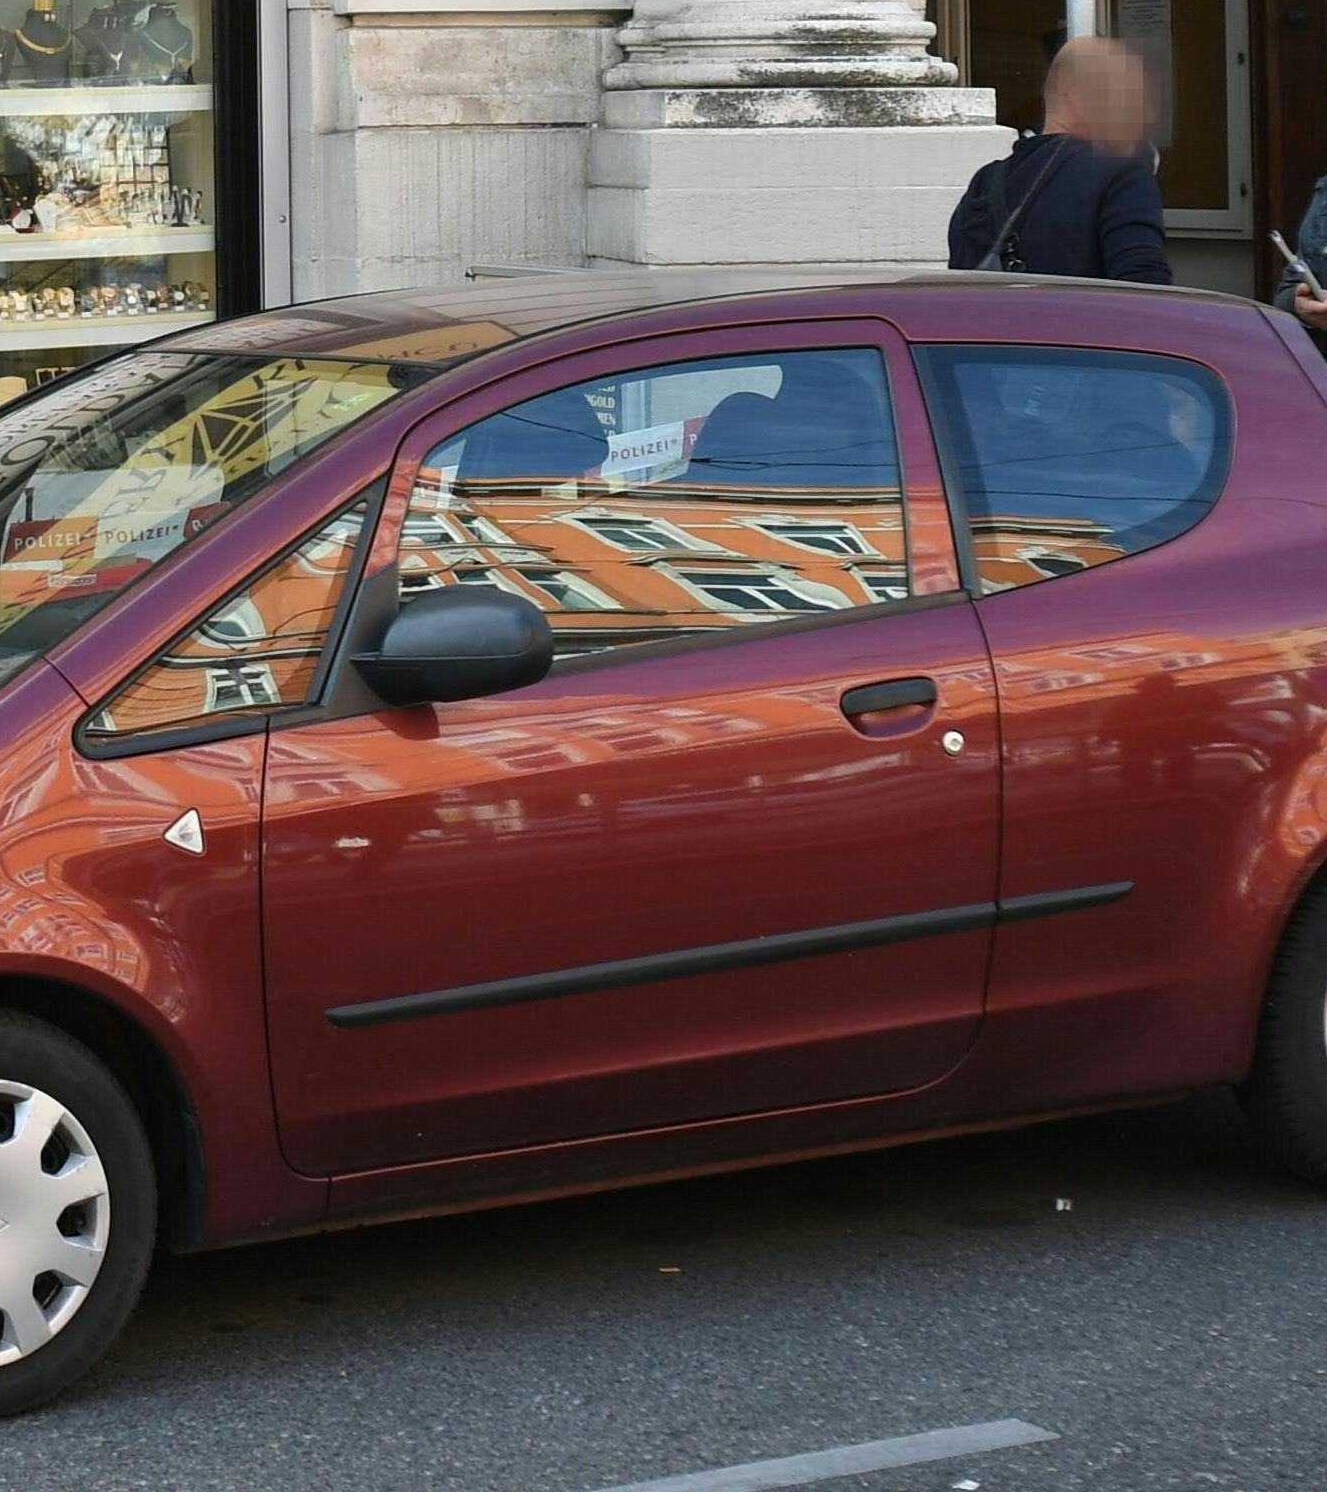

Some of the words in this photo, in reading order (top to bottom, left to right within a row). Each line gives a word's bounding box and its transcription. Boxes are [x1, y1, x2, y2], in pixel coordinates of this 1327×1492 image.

[610, 440, 669, 462] POLIZEI
[13, 531, 82, 551] POLIZEI
[105, 525, 171, 544] POLIZEI
